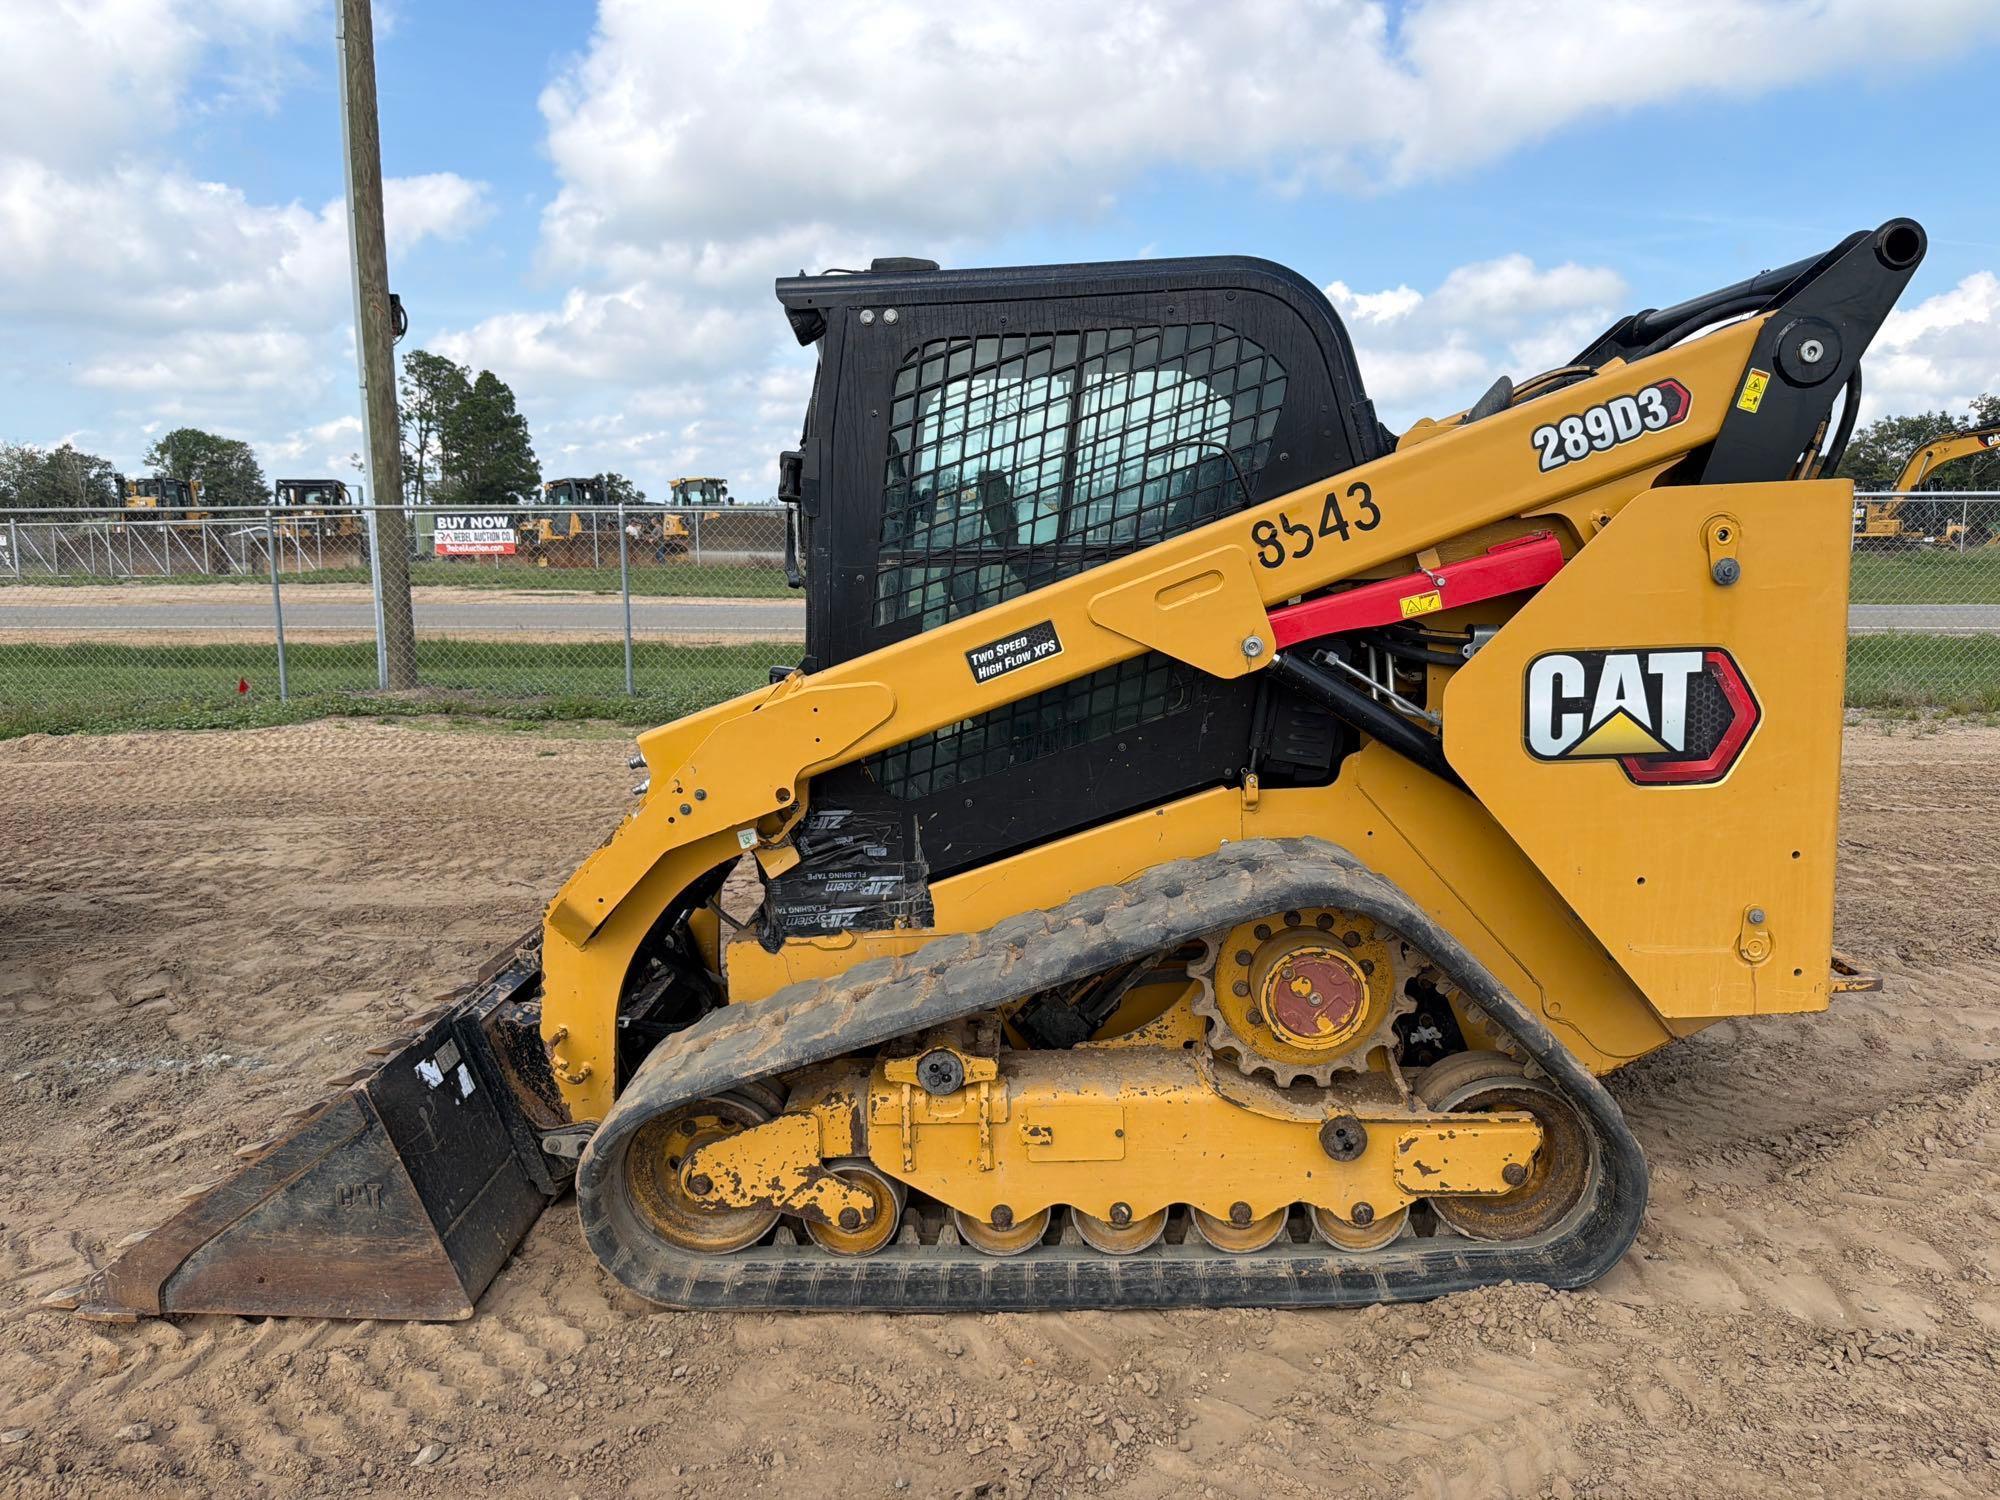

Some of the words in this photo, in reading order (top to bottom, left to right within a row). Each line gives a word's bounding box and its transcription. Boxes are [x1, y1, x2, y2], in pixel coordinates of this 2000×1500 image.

[1533, 387, 1668, 470] 289D3
[1988, 433, 2000, 446] CA
[437, 516, 466, 529] BUY
[470, 516, 508, 529] NOW
[1251, 481, 1381, 568] 8543
[453, 532, 472, 542] REBEL
[473, 532, 500, 542] AUCTION
[1034, 639, 1056, 658] XPS
[1529, 651, 1703, 757] CAT
[807, 872, 826, 880] TAPE
[829, 870, 867, 879] FLASHING
[861, 881, 897, 895] ZIP
[788, 903, 827, 913] FLASHING
